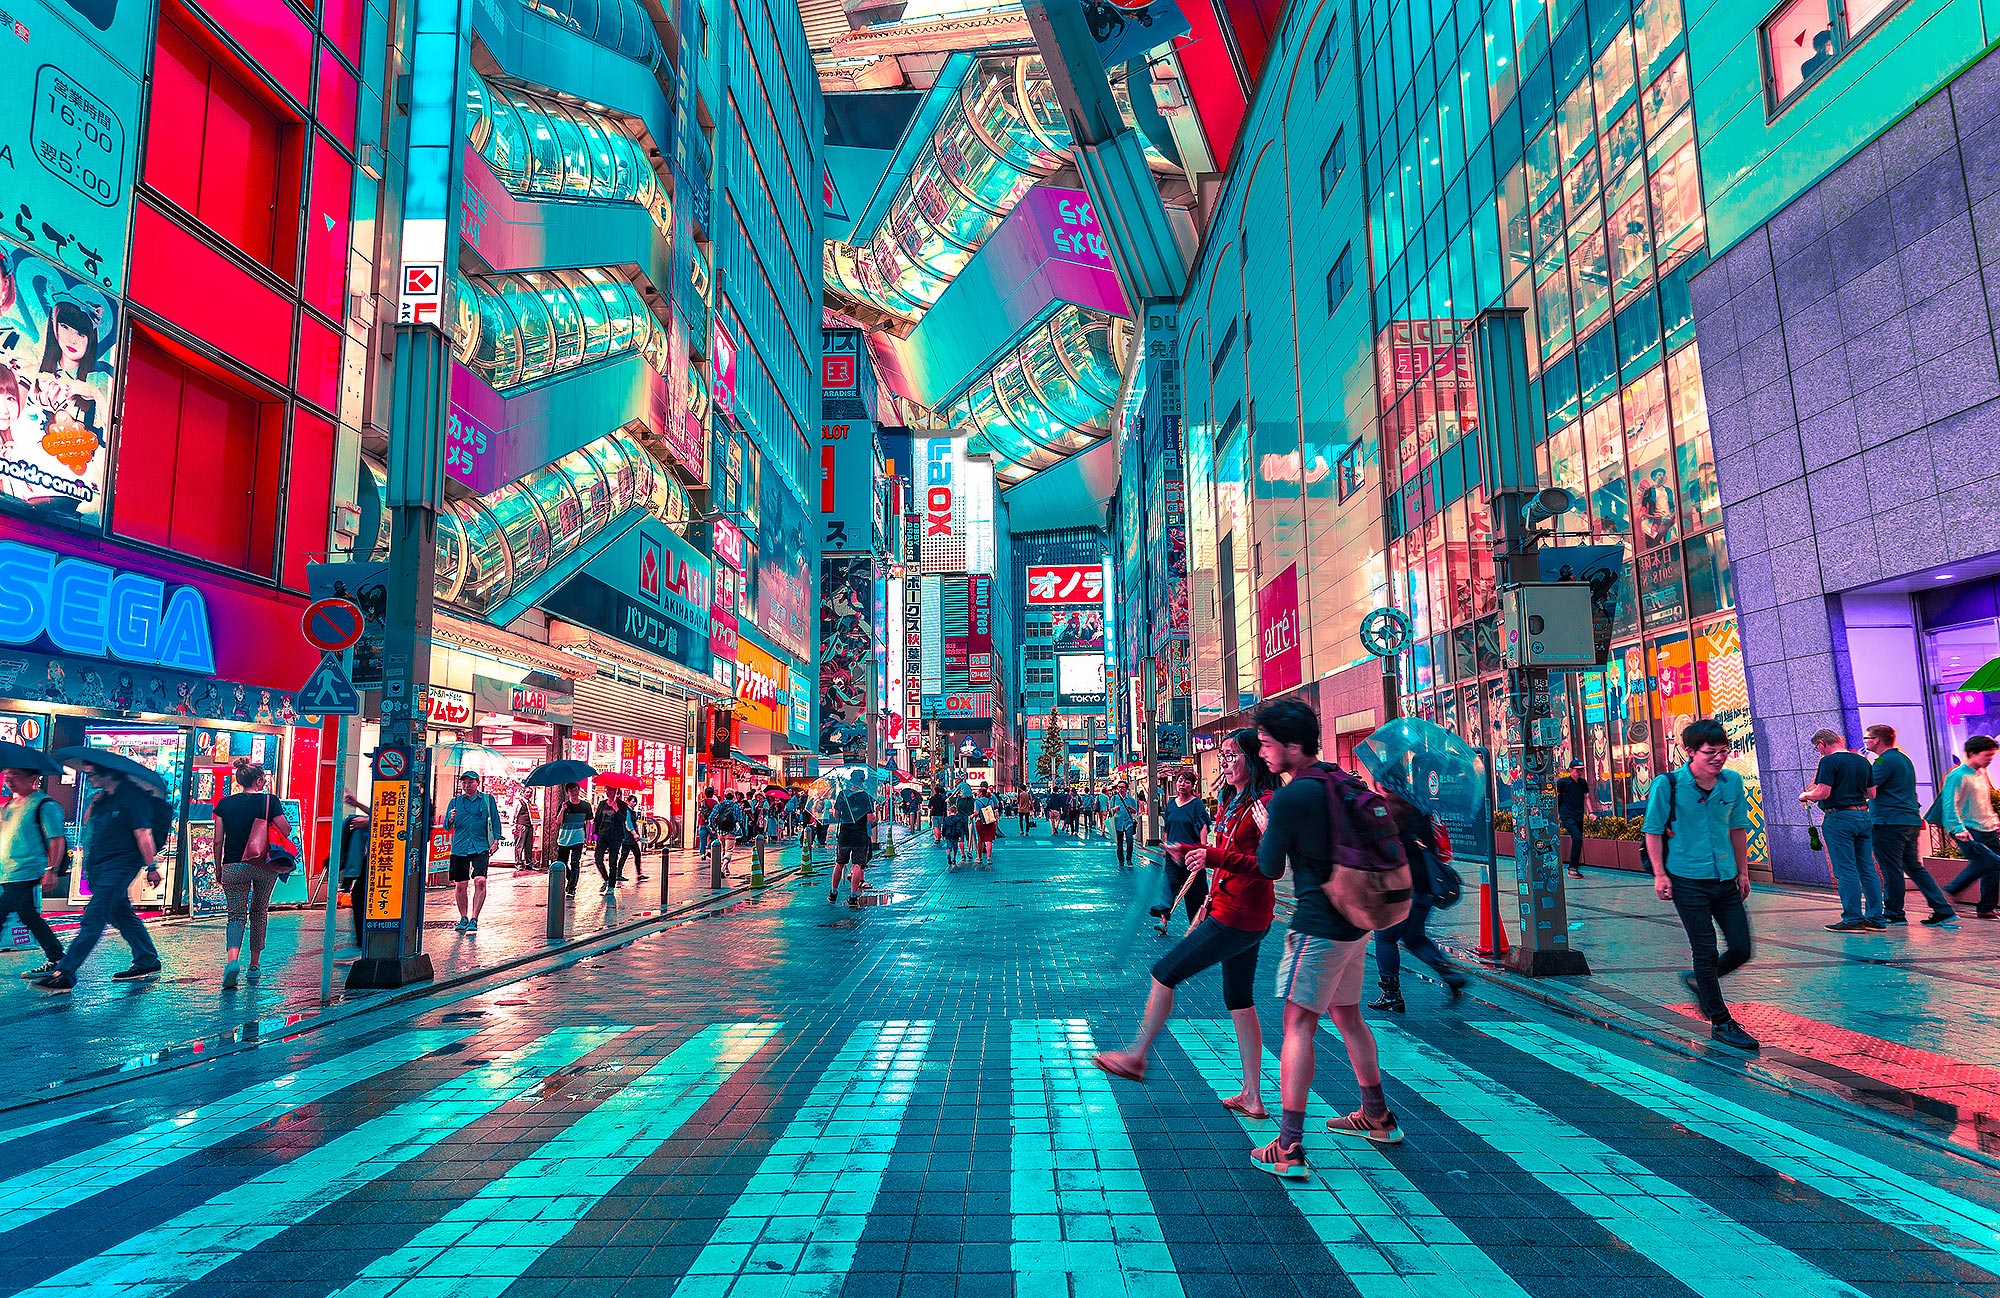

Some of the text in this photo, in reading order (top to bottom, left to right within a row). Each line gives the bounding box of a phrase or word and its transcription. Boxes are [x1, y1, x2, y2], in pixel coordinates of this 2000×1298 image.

[48, 94, 113, 153] 16:00
[53, 77, 112, 132] 営業時間
[40, 140, 111, 200] 翌5:00
[1059, 200, 1093, 227] メラ
[1053, 228, 1108, 260] カメラ
[449, 413, 487, 454] カメラ
[447, 445, 474, 475] メラ
[666, 548, 709, 613] LABI
[0, 541, 216, 675] SEGA
[664, 596, 709, 632] AKIHABARA
[976, 608, 990, 635] Free
[625, 606, 678, 655] パソコン館
[1264, 610, 1290, 658] atré
[524, 691, 547, 709] LABI
[1070, 695, 1101, 703] TOKYO
[397, 784, 407, 827] 千代田区内は
[376, 790, 397, 915] 路上喫煙禁止です。
